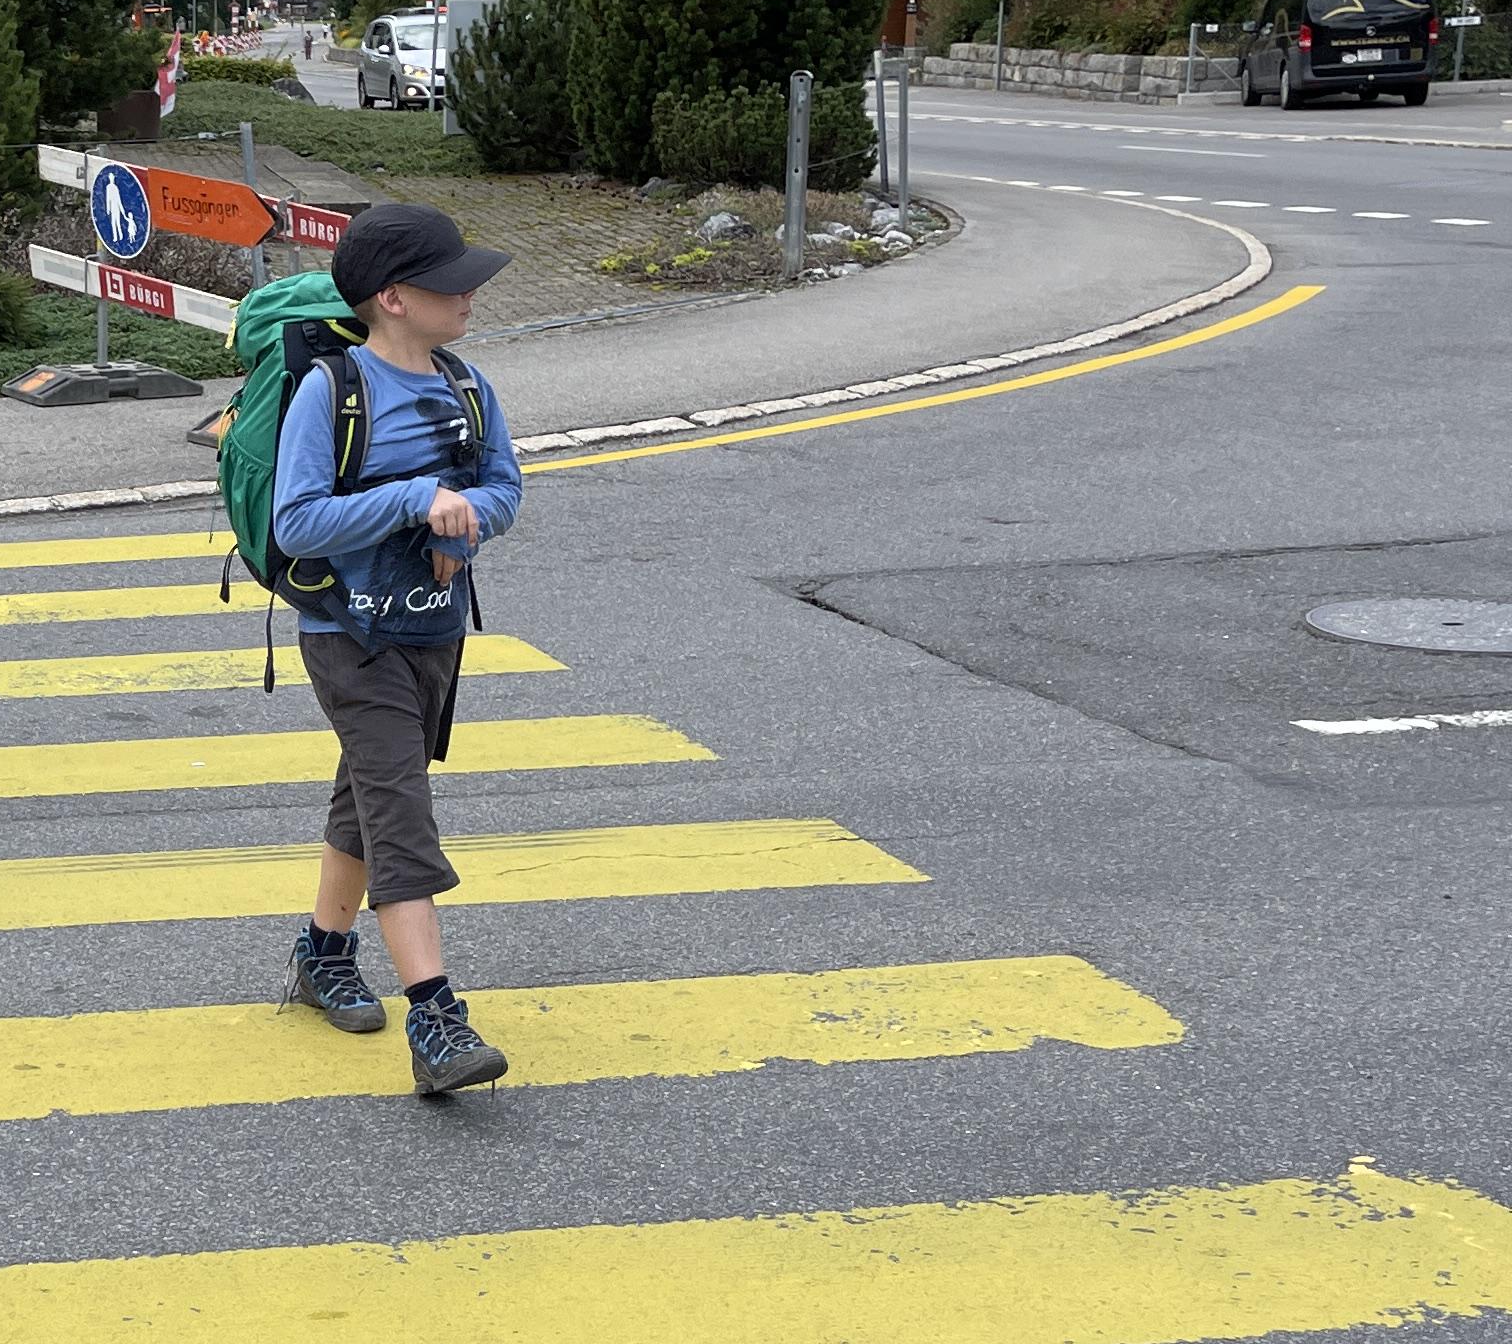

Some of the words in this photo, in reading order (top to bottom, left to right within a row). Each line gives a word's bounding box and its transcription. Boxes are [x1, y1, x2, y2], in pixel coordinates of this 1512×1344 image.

[299, 216, 341, 244] BÜRGI
[129, 283, 165, 309] BÜRGI
[405, 580, 453, 612] Cool
